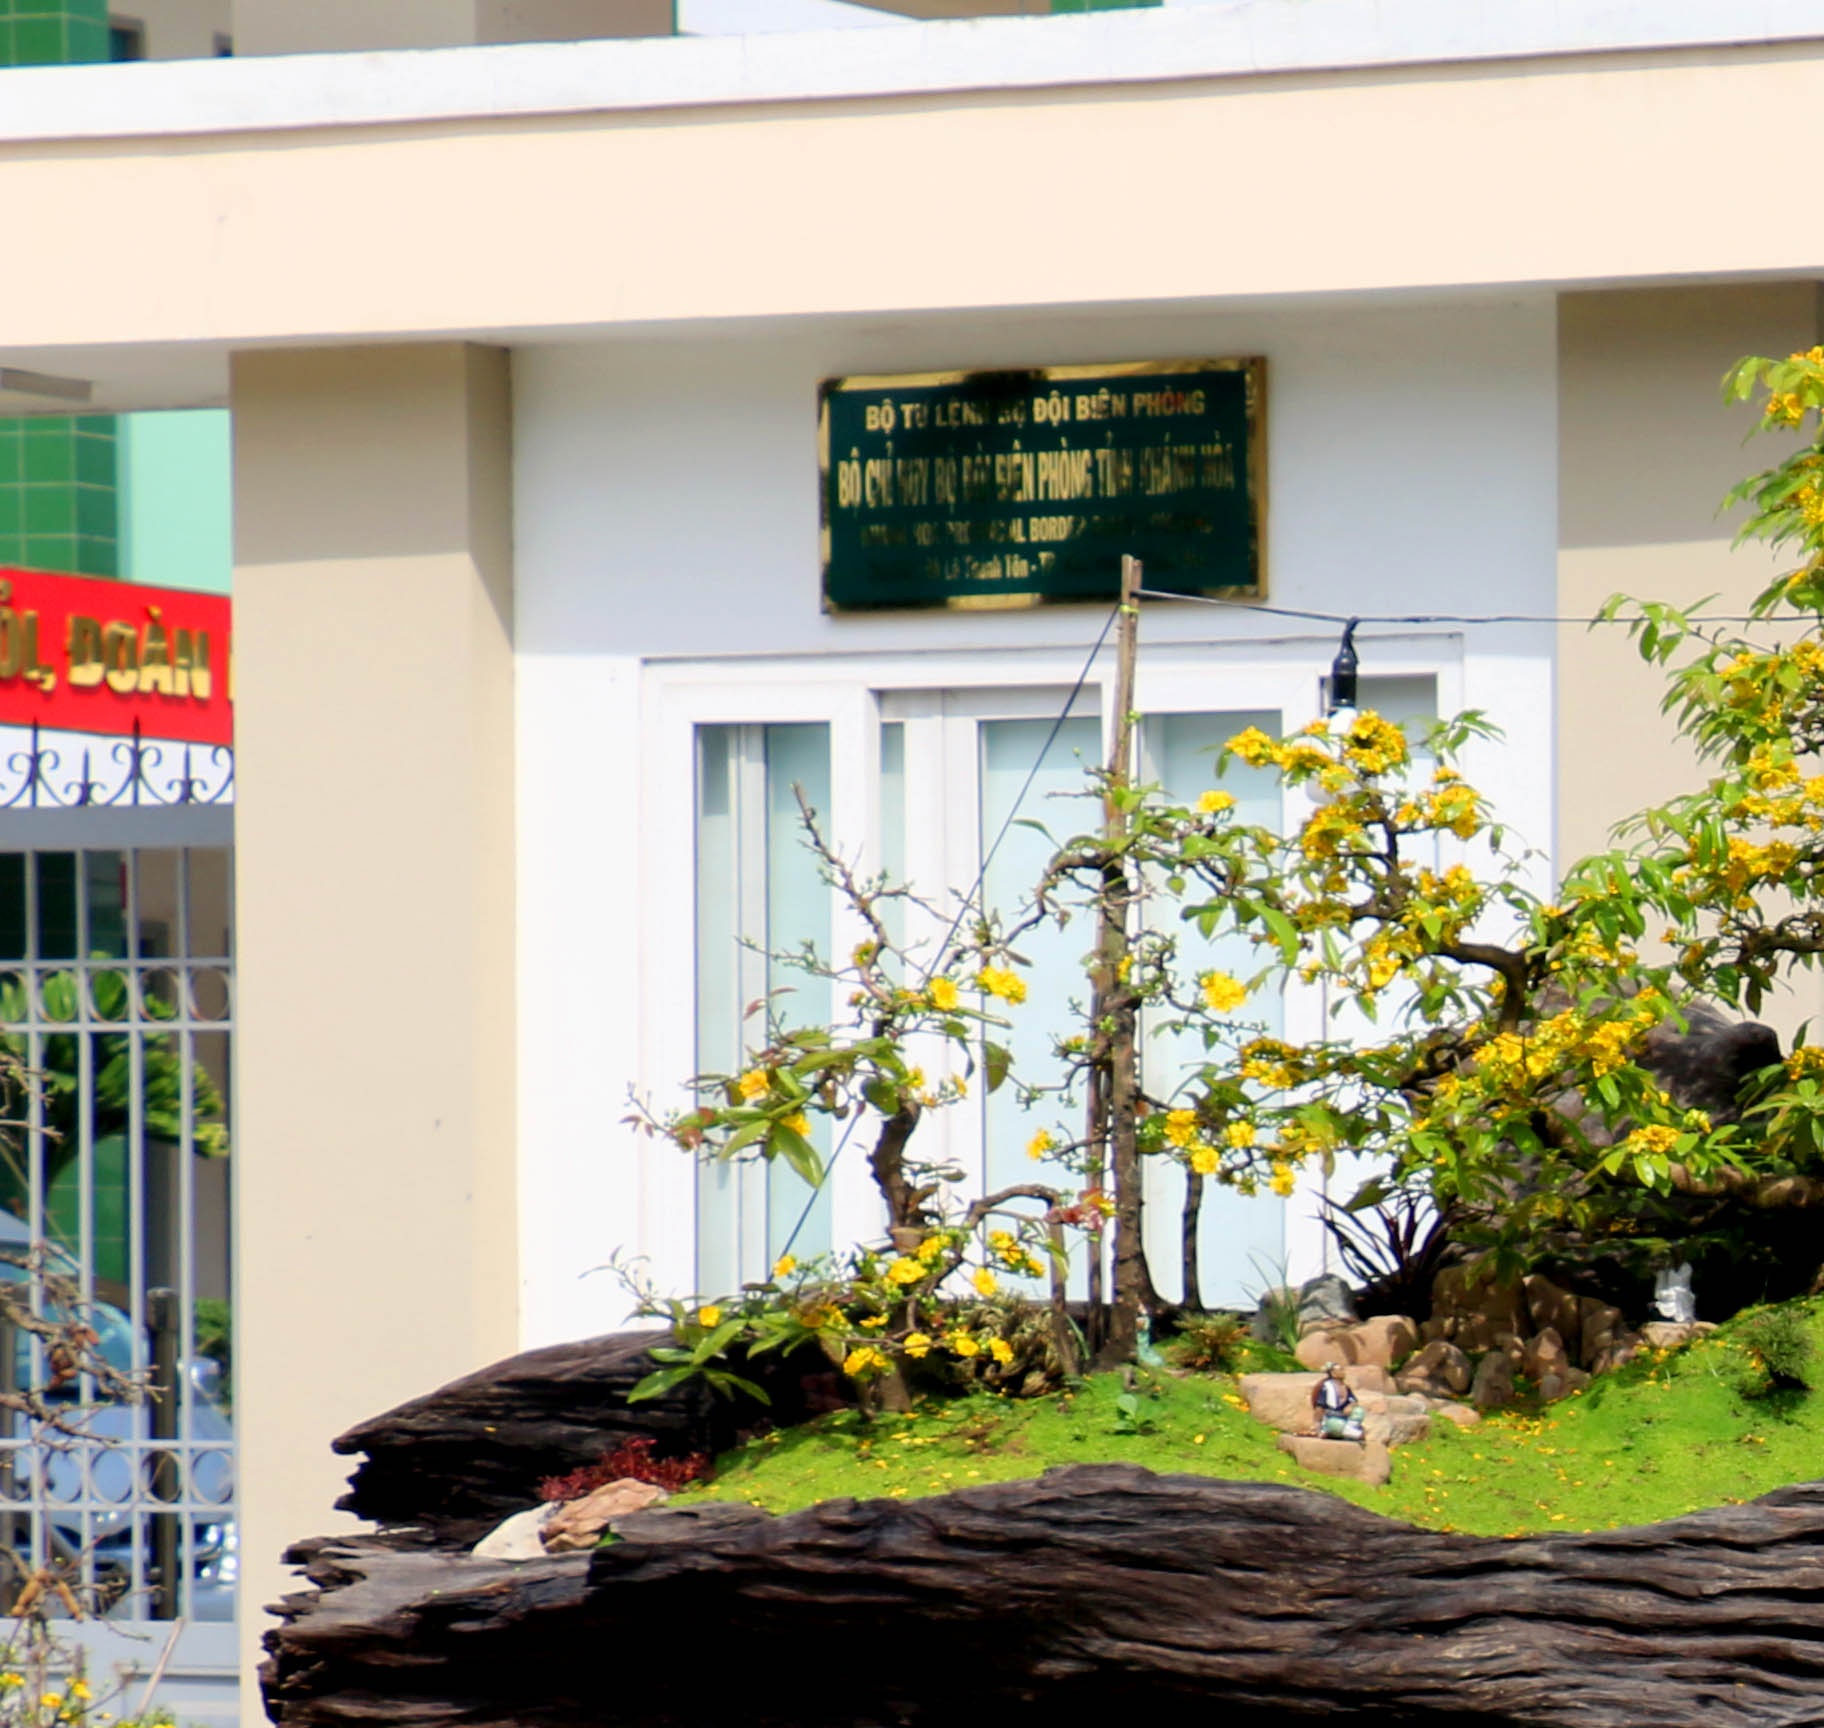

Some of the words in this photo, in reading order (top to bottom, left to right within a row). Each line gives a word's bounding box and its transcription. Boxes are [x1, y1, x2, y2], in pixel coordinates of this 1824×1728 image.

[865, 397, 896, 435] BỘ
[1032, 389, 1070, 427] ĐỘI
[1075, 387, 1126, 421] BIÊN
[1133, 385, 1207, 416] PHÒNG
[1037, 435, 1092, 501] PHÒNG
[66, 605, 212, 700] ĐOÀN
